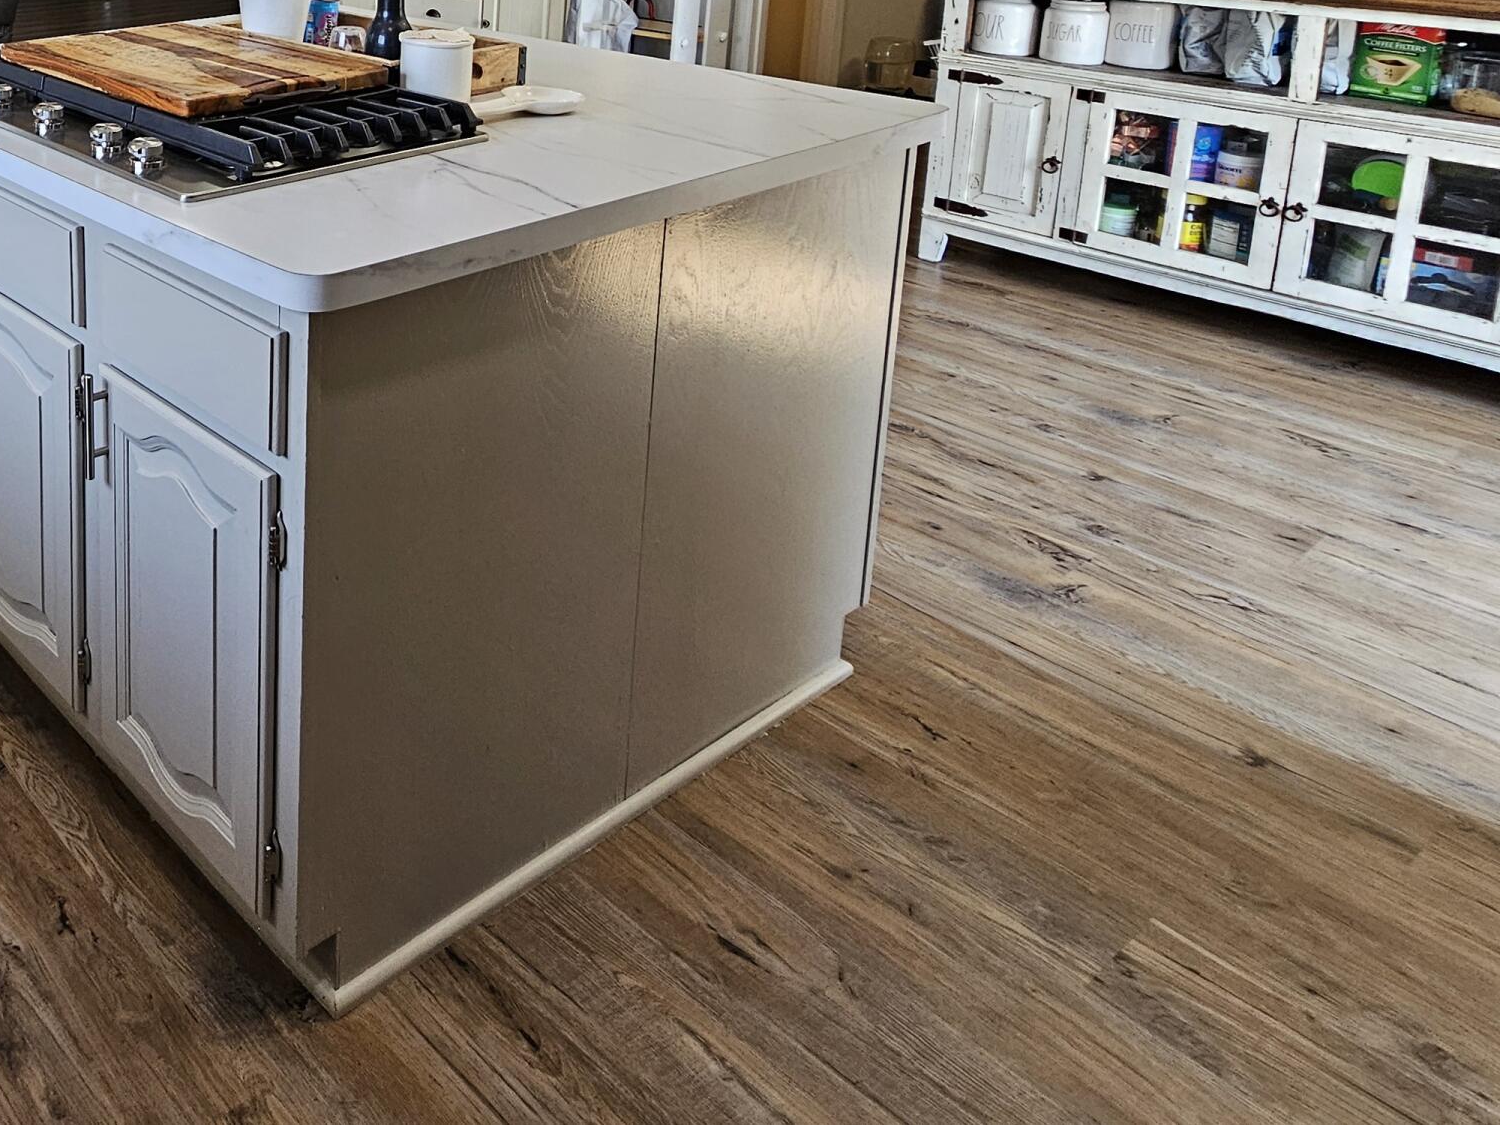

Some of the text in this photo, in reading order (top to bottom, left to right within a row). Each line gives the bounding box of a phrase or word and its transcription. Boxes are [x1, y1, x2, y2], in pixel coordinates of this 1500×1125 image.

[1047, 21, 1082, 43] SUGAR
[1114, 22, 1154, 44] COFFEE
[1363, 38, 1427, 53] COFFEE FILTERS
